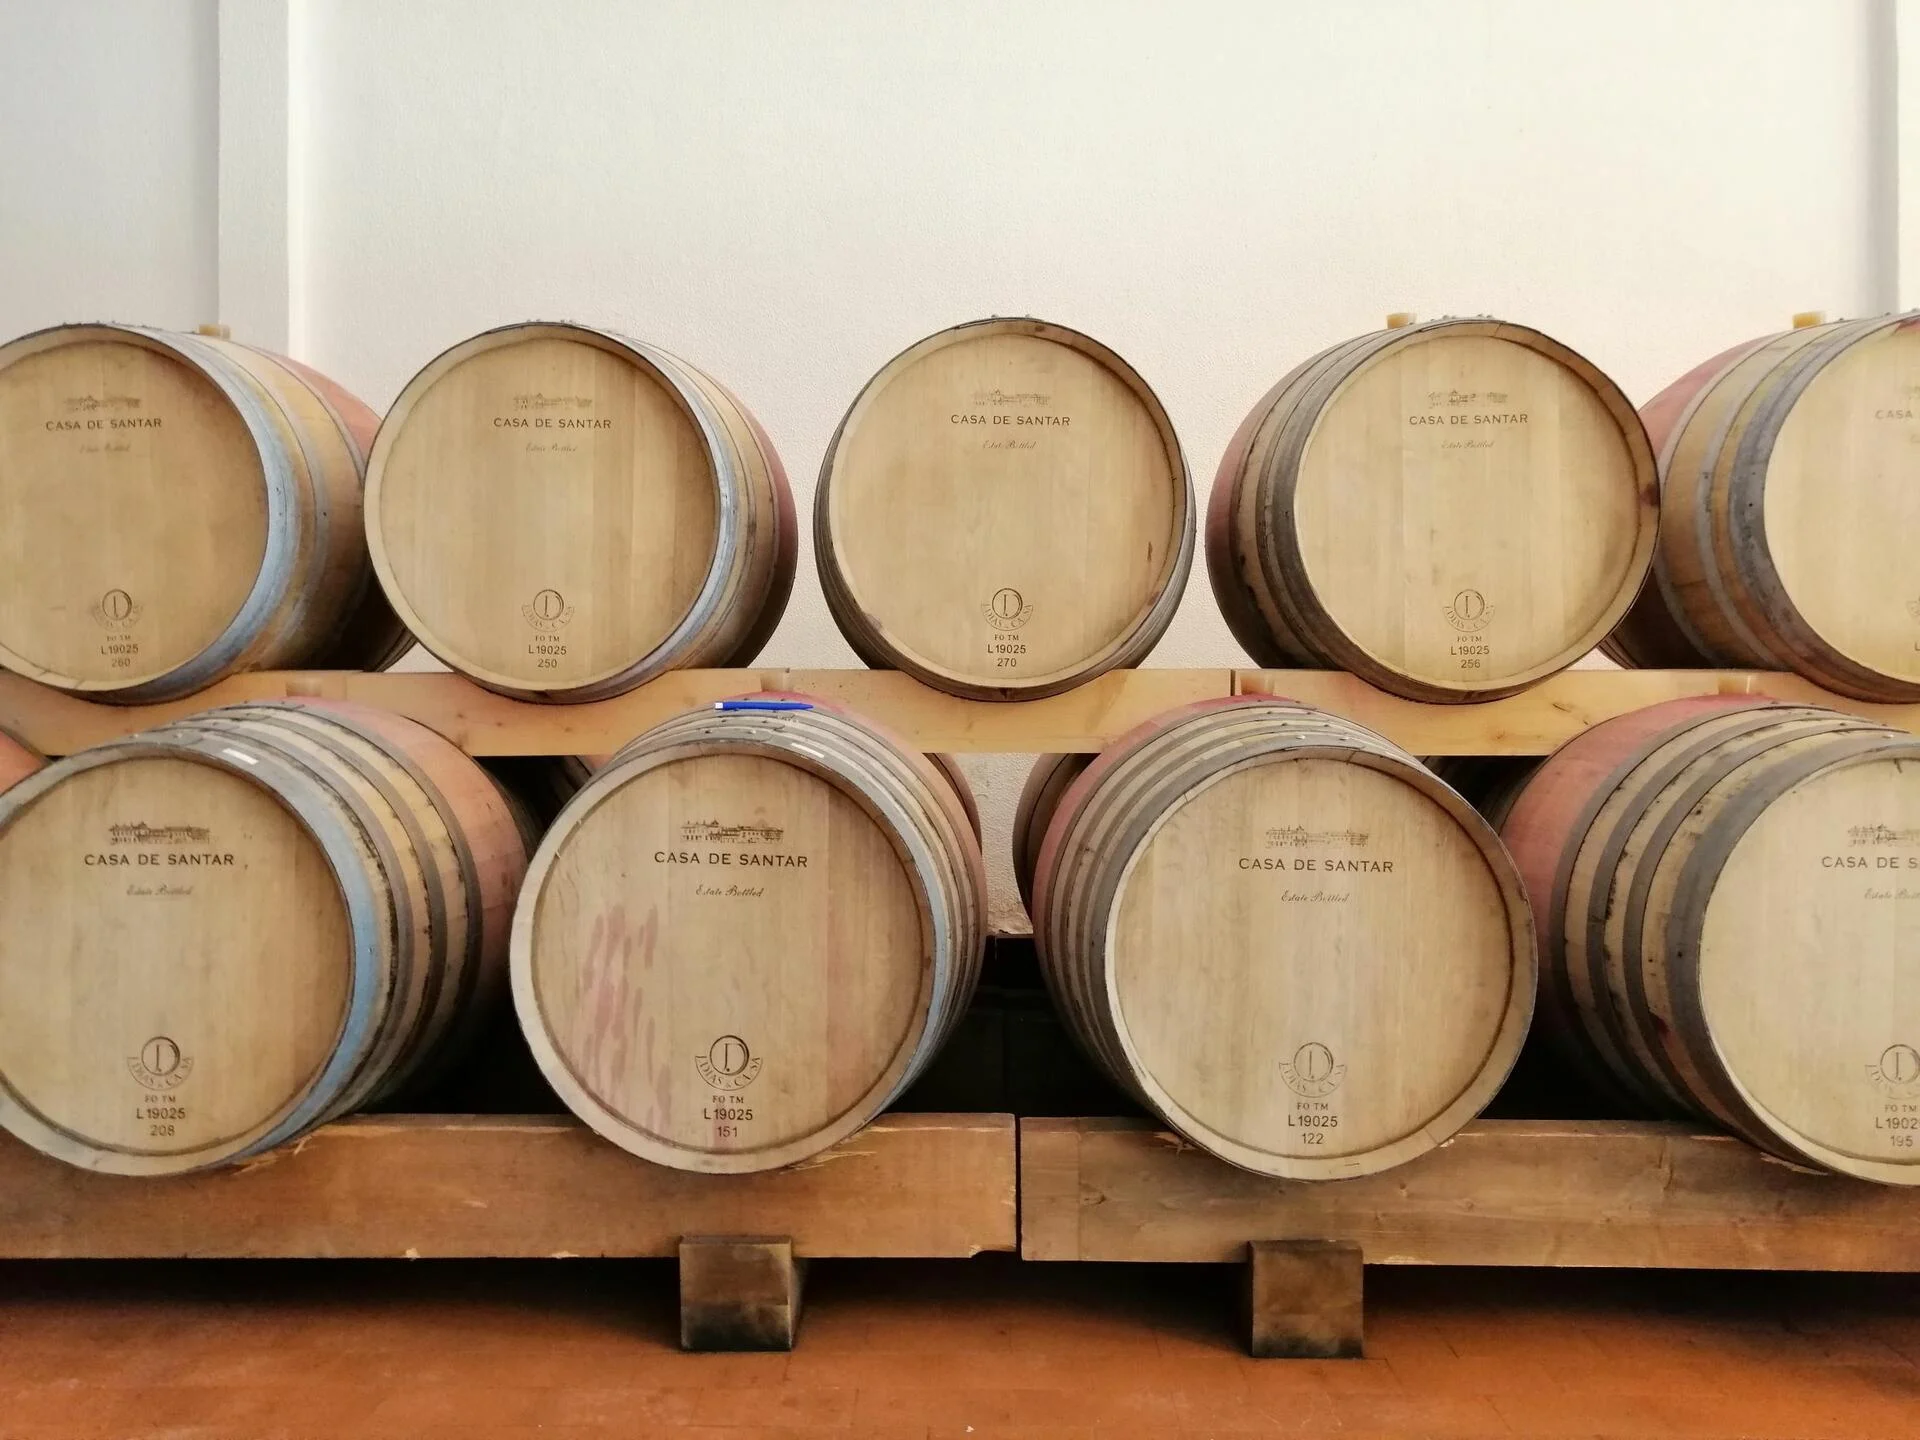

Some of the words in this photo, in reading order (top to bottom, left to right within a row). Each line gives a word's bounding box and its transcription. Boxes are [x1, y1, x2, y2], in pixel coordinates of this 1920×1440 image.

[950, 414, 987, 425] CASA
[993, 415, 1012, 425] DE
[1016, 415, 1071, 426] SANTAR
[1409, 415, 1445, 425] CASA
[1450, 415, 1469, 425] DE
[1474, 413, 1528, 425] SANTAR
[1874, 409, 1914, 420] CASA
[46, 420, 81, 431] CASA
[87, 420, 104, 430] DE
[110, 418, 162, 429] SANTAR
[493, 417, 529, 428] CASA
[535, 418, 553, 428] DE
[558, 418, 612, 429] SANTAR
[101, 644, 139, 655] L19025
[528, 644, 567, 655] L19025
[987, 644, 1026, 654] L19025
[1450, 645, 1490, 655] L19025
[537, 658, 558, 669] 250
[997, 657, 1017, 668] 270
[1461, 658, 1481, 669] 256
[84, 853, 130, 866] CASA
[138, 854, 160, 866] DE
[167, 853, 234, 866] SANTAR
[654, 851, 700, 864] CASA
[709, 853, 732, 865] DE
[739, 854, 808, 868] SANTAR
[1239, 857, 1285, 870] CASA
[1294, 859, 1317, 871] DE
[1324, 860, 1394, 873] SANTAR
[1821, 856, 1868, 868] CASA
[1876, 857, 1900, 869] DE
[695, 882, 722, 896] Estate
[725, 884, 765, 897] Bottled
[1280, 889, 1308, 902] Estate
[1310, 891, 1350, 903] Bottled
[712, 1095, 726, 1104] FO
[730, 1095, 744, 1104] TM
[1297, 1102, 1310, 1111] FO
[1314, 1103, 1329, 1111] TM
[1902, 1104, 1918, 1113] TM
[136, 1107, 186, 1120] L19025
[703, 1107, 754, 1120] L19025
[1288, 1114, 1339, 1127] L19025
[1875, 1116, 1920, 1130] L1902
[149, 1124, 176, 1137] 208
[717, 1125, 738, 1138] 151
[1302, 1132, 1325, 1145] 122
[1890, 1135, 1914, 1148] 195
